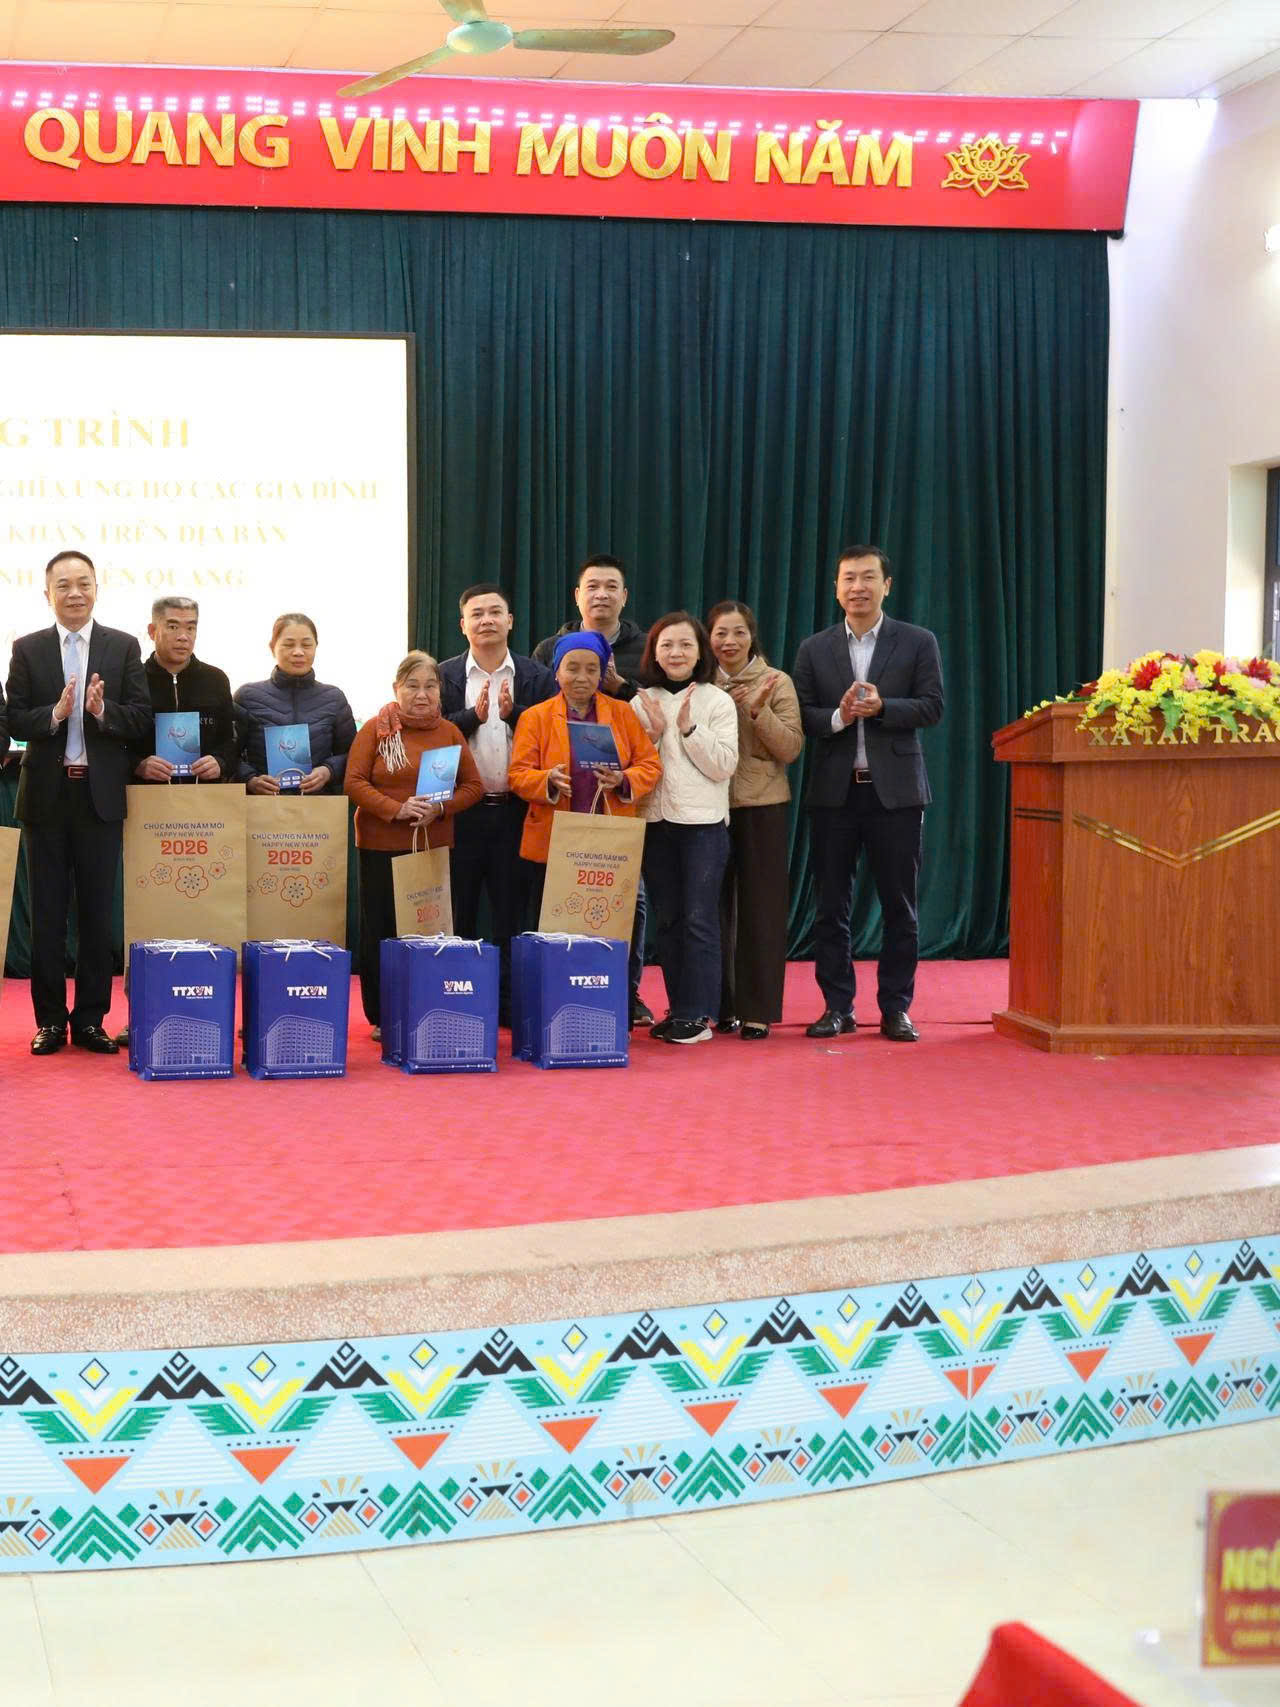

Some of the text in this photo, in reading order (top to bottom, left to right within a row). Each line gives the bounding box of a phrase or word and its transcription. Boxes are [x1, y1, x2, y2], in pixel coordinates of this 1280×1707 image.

[23, 107, 290, 170] QUANG
[319, 116, 489, 174] VINH
[516, 112, 730, 182] MUÔN
[755, 119, 912, 188] NĂM
[43, 406, 193, 450] TRÌNH
[161, 839, 208, 855] 2026
[267, 850, 313, 865] 2026
[577, 869, 615, 887] 2026
[443, 980, 474, 992] VNA
[569, 975, 609, 986] TTXVN
[172, 986, 213, 997] TTXVN
[286, 986, 328, 997] TTXVN
